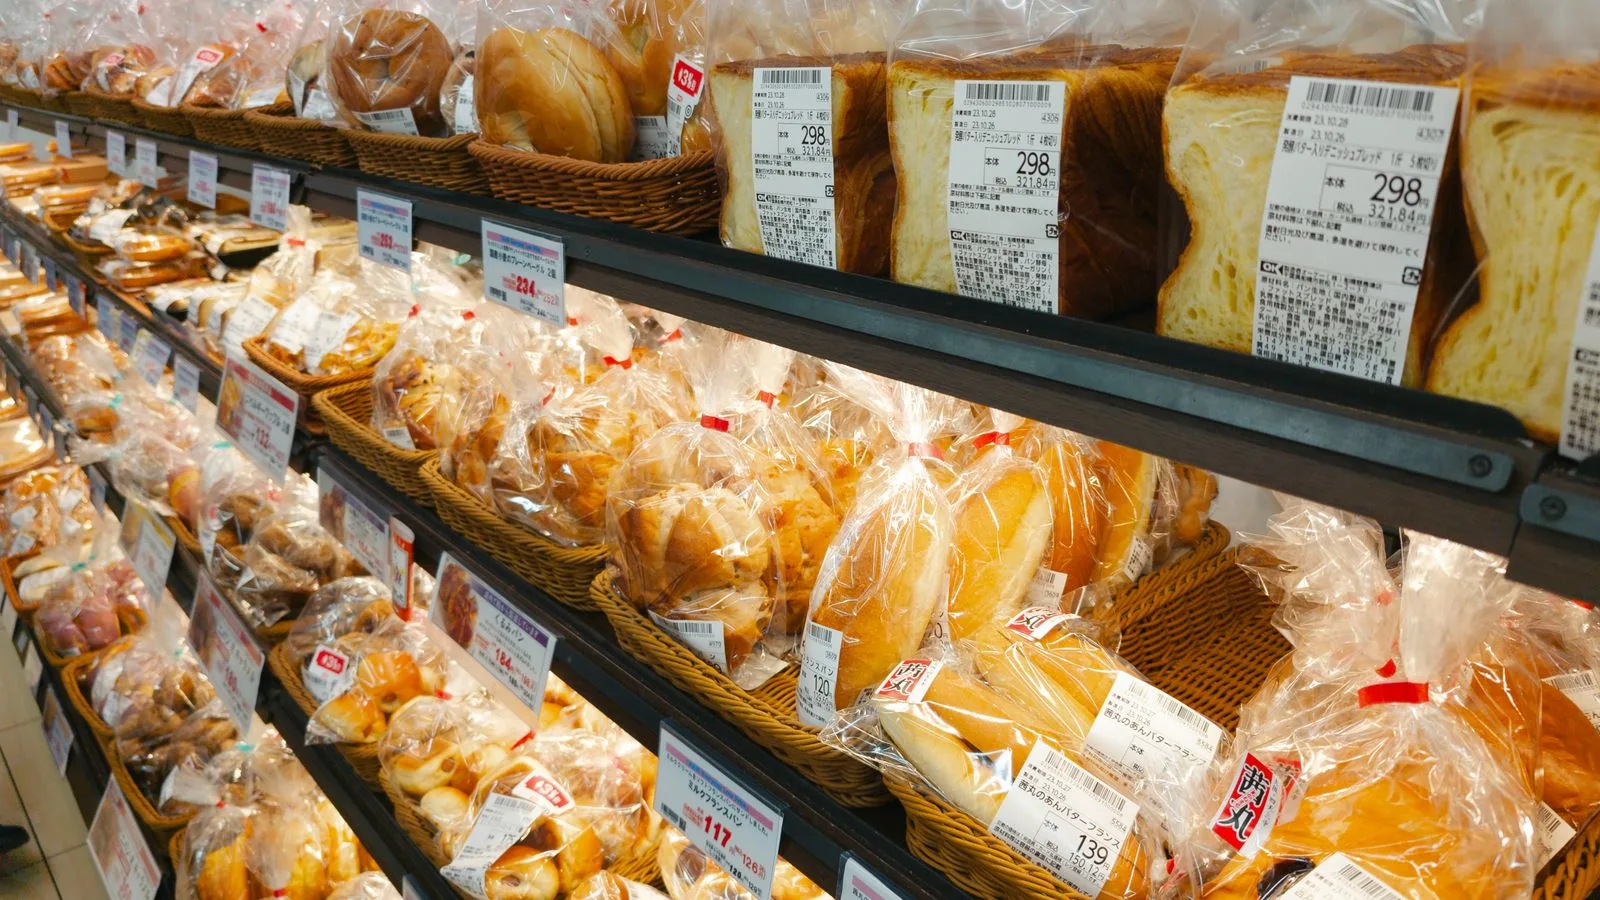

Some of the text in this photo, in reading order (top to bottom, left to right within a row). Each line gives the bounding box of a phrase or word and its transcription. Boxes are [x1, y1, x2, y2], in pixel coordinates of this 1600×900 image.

[1314, 114, 1349, 127] 23.10.28
[1311, 130, 1346, 142] 23.10.26
[985, 158, 999, 166] 本体
[1016, 151, 1056, 176] 298円
[1016, 176, 1056, 190] 321.84円
[1325, 177, 1346, 188] 本体
[1370, 173, 1430, 208] 298円
[1368, 203, 1427, 225] 321.84円
[952, 232, 964, 240] OK
[1263, 263, 1281, 274] OK
[516, 275, 535, 297] 234
[495, 614, 525, 642] くるみパン
[496, 648, 512, 670] 184
[883, 664, 927, 694] 茜丸
[1047, 774, 1071, 792] 23.10.27
[688, 780, 743, 826] ミルクフランスパン
[1218, 765, 1270, 840] 茜丸
[1018, 779, 1120, 849] 茜丸のあんバターフランス
[704, 815, 732, 848] 117
[1044, 820, 1058, 832] 本体
[1076, 834, 1110, 871] 139円
[1068, 852, 1105, 881] 150.12円
